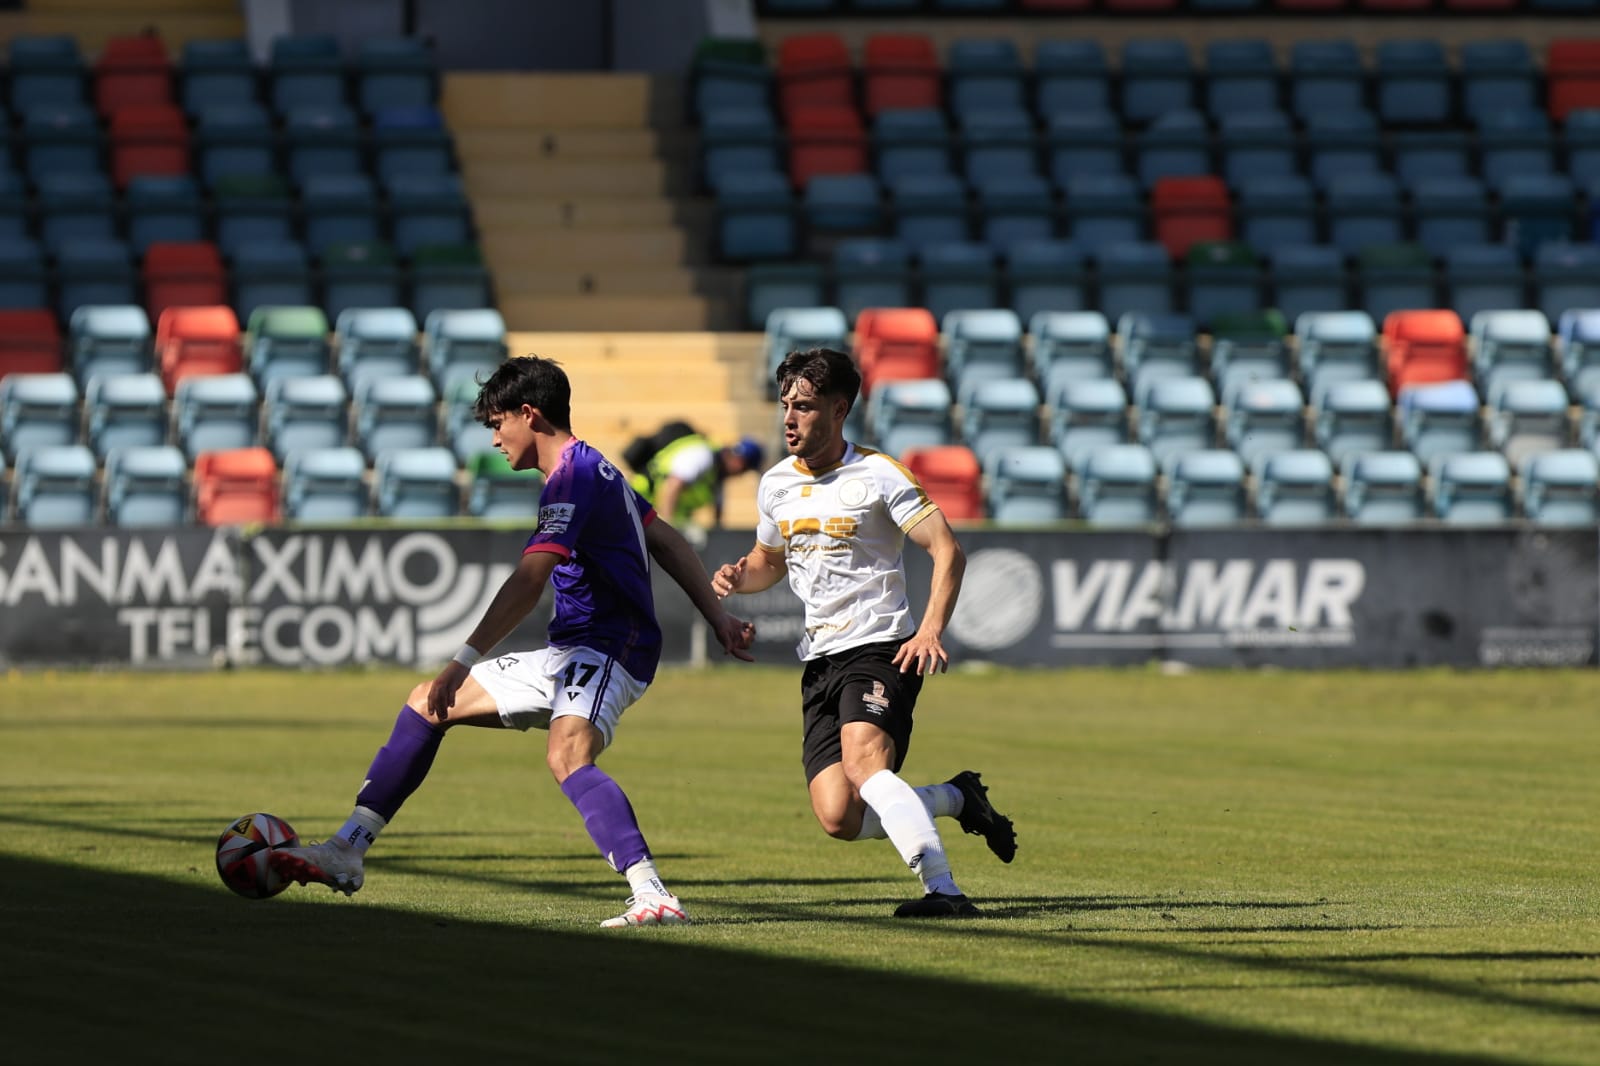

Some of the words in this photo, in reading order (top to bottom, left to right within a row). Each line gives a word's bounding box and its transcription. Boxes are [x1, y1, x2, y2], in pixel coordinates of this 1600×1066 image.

[0, 531, 458, 605] ANMAXIMO
[1051, 558, 1367, 632] VIAMAR
[117, 604, 415, 664] TELECOM
[564, 661, 601, 688] 17
